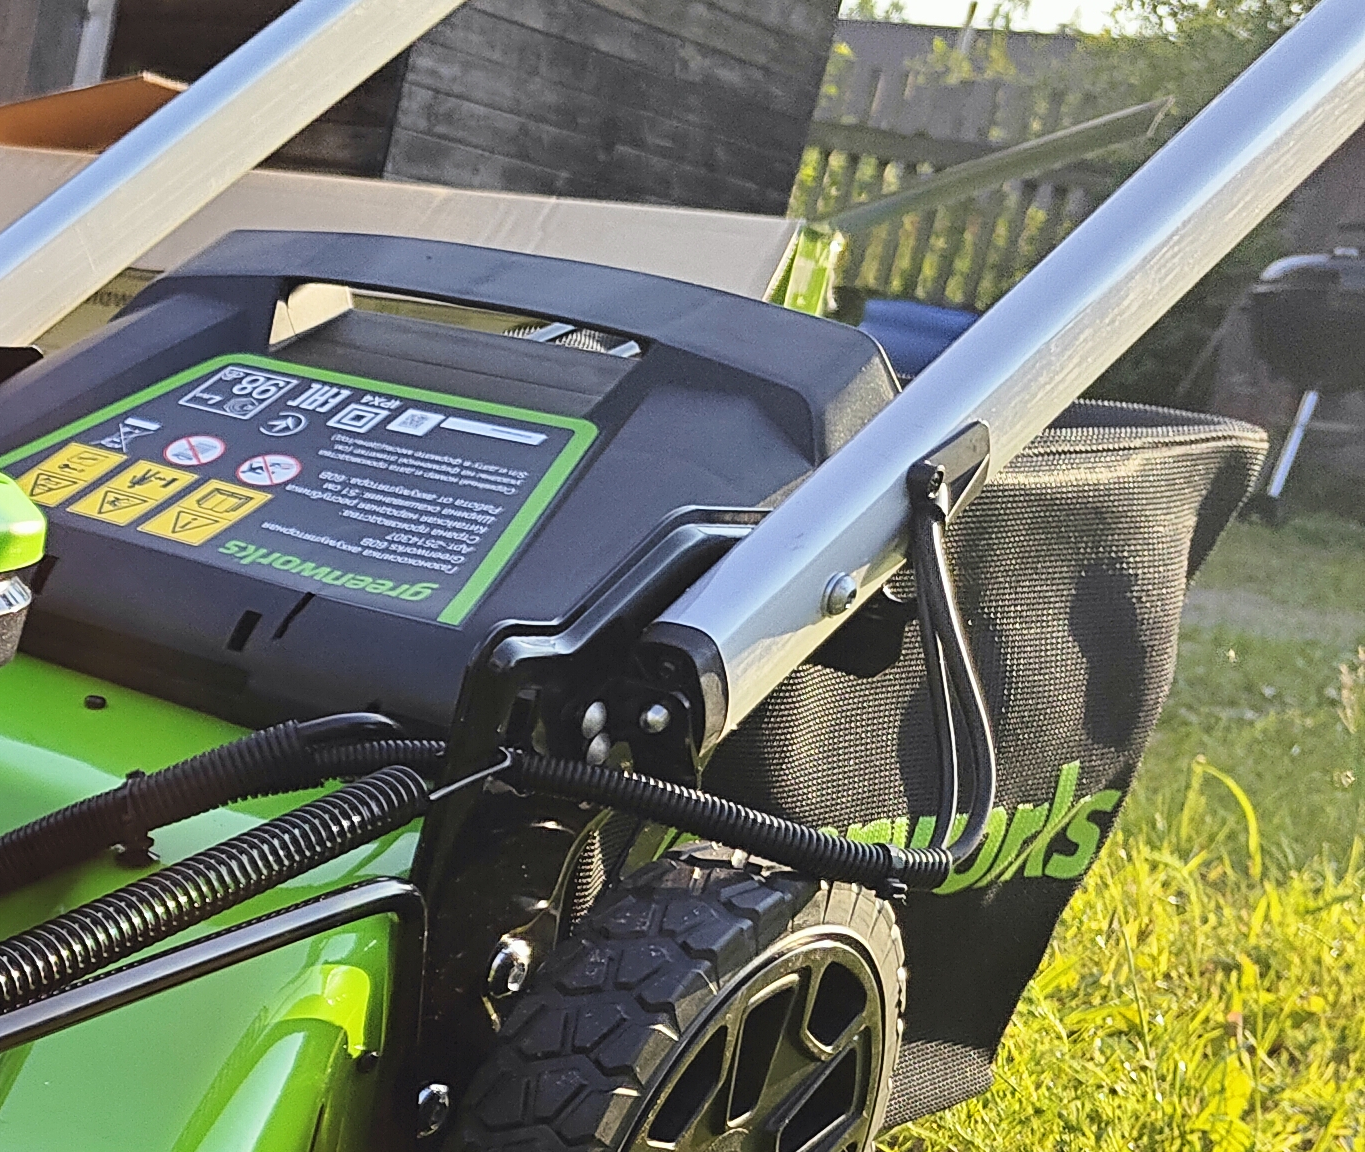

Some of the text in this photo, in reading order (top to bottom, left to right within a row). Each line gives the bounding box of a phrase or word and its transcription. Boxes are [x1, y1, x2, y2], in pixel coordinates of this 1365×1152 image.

[232, 375, 286, 399] 98
[360, 393, 402, 409] IPX4
[341, 487, 361, 496] 51
[454, 499, 503, 514] Работа
[441, 508, 496, 524] Ширина
[431, 528, 480, 544] Страна
[389, 544, 464, 563] Greenworks
[218, 540, 440, 602] greenworks
